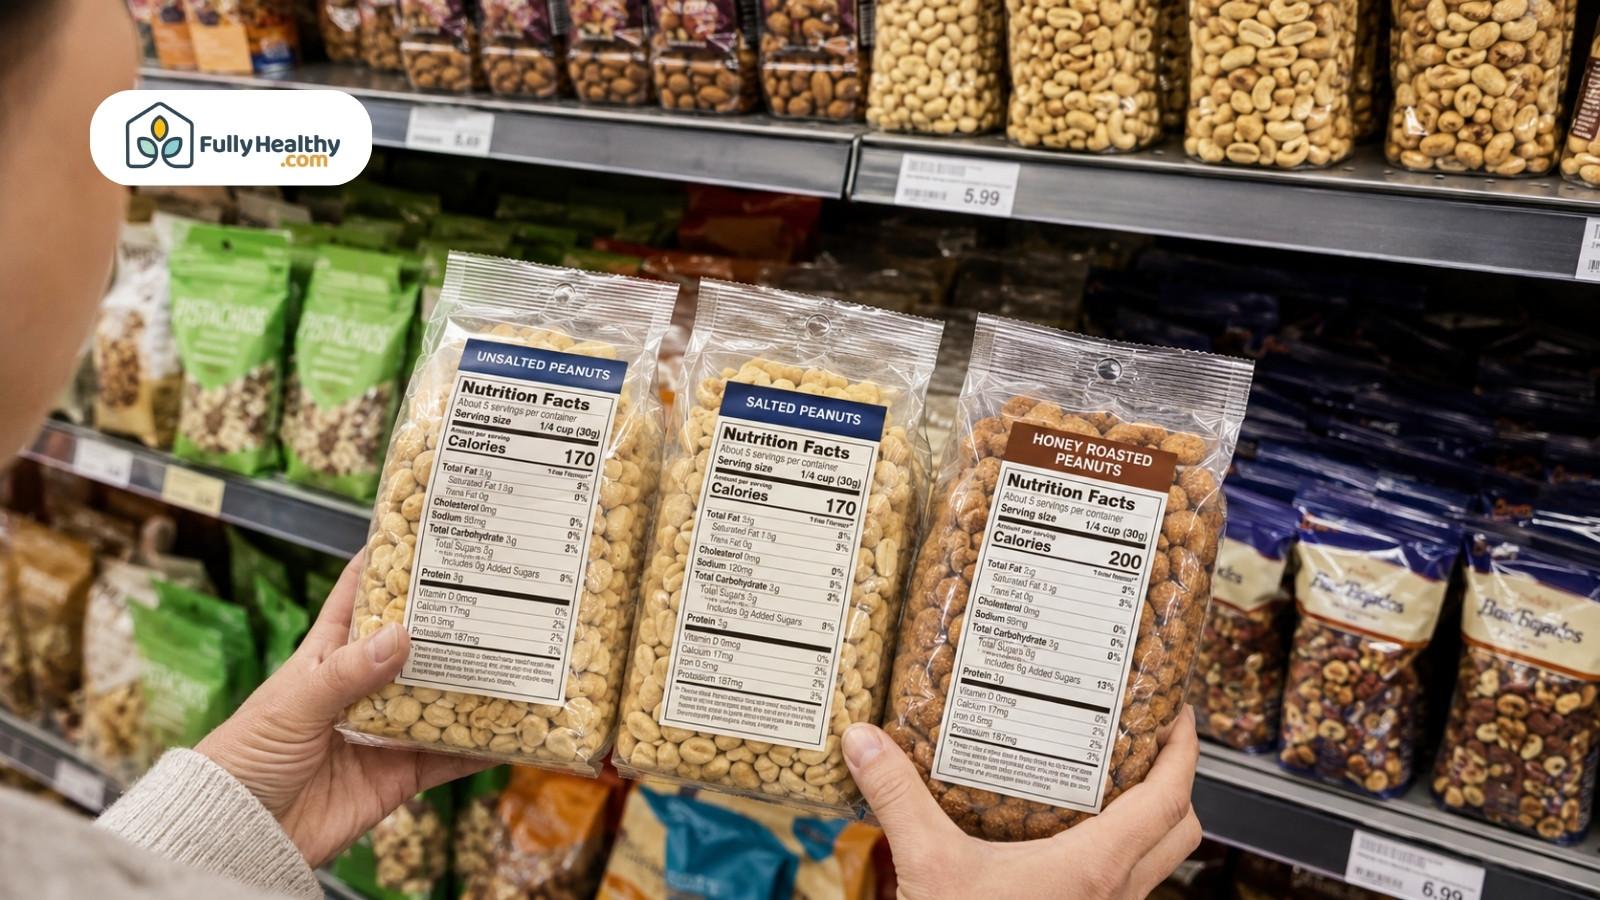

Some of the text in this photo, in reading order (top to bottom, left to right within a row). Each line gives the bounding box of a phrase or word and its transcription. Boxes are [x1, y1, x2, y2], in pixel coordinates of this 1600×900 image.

[964, 188, 1000, 206] 5.99
[477, 352, 610, 380] UNSALTED PEANUTS
[462, 381, 590, 411] Nutrition Facts
[457, 398, 482, 408] About
[483, 401, 489, 410] 5
[491, 404, 524, 416] servings
[540, 412, 577, 422] container
[746, 397, 861, 425] SALTED PEANUTS
[455, 409, 600, 440] Serving size 1/4 cup (30g)
[448, 435, 595, 466] Calories 170
[724, 427, 849, 459] Nutrition Facts
[1033, 433, 1152, 466] HONEY ROASTED
[720, 444, 744, 456] About
[753, 451, 785, 464] servings
[443, 463, 478, 475] Total Fat
[718, 456, 861, 489] Serving size 1/4 cup (30g)
[1056, 453, 1121, 476] PEANUTS
[484, 481, 496, 490] Fat
[1008, 474, 1135, 510] Nutrition Facts
[434, 498, 479, 511] Cholesterol
[712, 482, 856, 516] Calories 170
[1003, 492, 1123, 523] About 5 servings per container
[707, 510, 740, 522] Total Fat
[1001, 503, 1148, 542] Serving size 1/4 cup (30g)
[430, 523, 504, 542] Total Carbohydrate
[748, 528, 760, 538] Fat
[994, 531, 1142, 569] Calories 200
[486, 563, 512, 574] Added
[513, 566, 540, 579] Sugars
[697, 558, 726, 569] Sodium
[988, 559, 1008, 570] Total
[1009, 563, 1022, 573] Fat
[422, 568, 451, 580] Protein
[695, 570, 767, 590] Total Carbohydrate
[1010, 589, 1023, 600] Fat
[1029, 580, 1041, 590] Fat
[448, 592, 455, 600] D
[555, 607, 567, 617] 0%
[450, 605, 470, 618] 17mg
[552, 620, 565, 629] 2%
[687, 613, 716, 625] Protein
[750, 610, 775, 621] Added
[776, 614, 802, 626] Sugars
[975, 609, 1005, 622] Sodium
[550, 633, 563, 642] 2%
[973, 622, 992, 634] Total
[994, 628, 1047, 646] Carbohydrate
[712, 637, 719, 645] D
[817, 654, 829, 664] 0%
[714, 650, 734, 662] 17mg
[963, 667, 992, 679] Protein
[1028, 666, 1053, 678] Added
[1054, 671, 1080, 684] Sugars
[1097, 681, 1114, 692] 13%
[987, 692, 994, 700] D
[1094, 715, 1107, 724] 0%
[989, 705, 1009, 718] 17mg
[993, 732, 1017, 746] 187mg
[1422, 881, 1462, 900] 6.99
